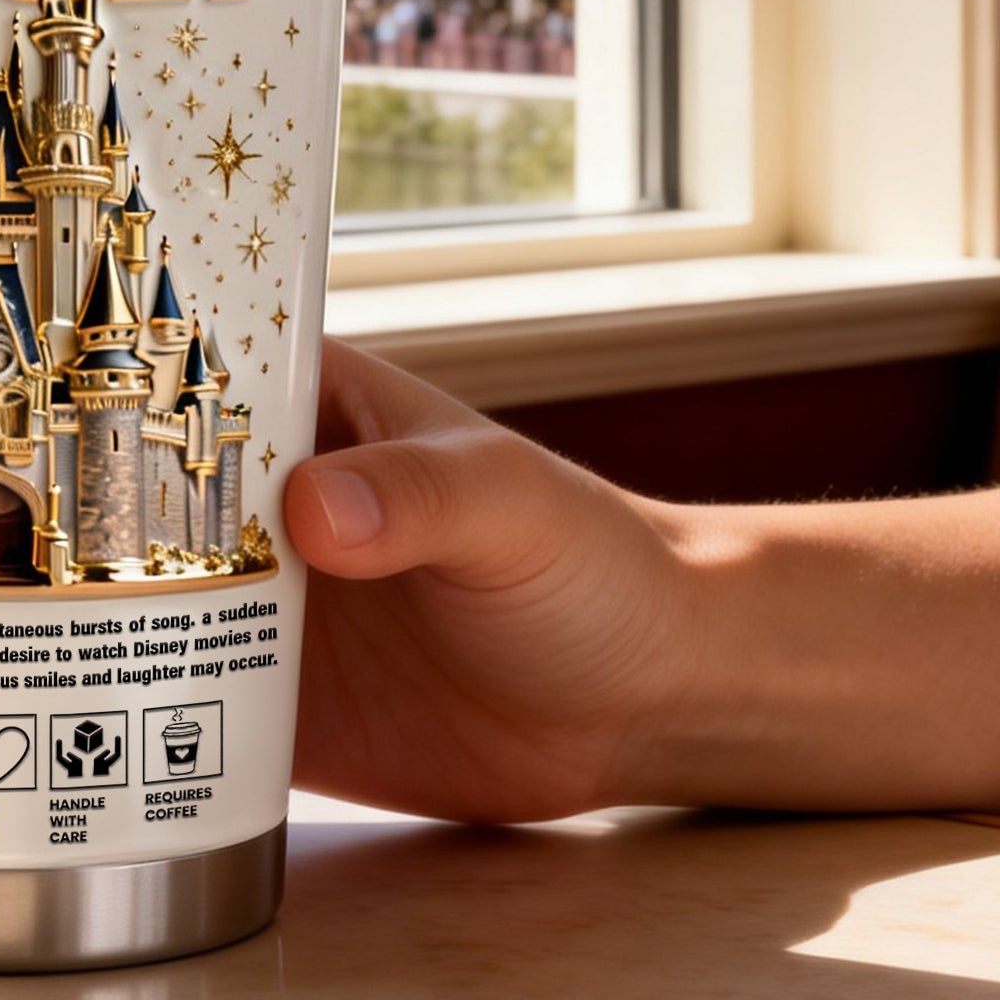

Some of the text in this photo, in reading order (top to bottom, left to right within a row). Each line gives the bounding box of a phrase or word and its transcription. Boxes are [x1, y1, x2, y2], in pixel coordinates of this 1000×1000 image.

[70, 619, 122, 636] bursts
[129, 616, 146, 632] of
[151, 614, 195, 631] song.
[202, 612, 211, 624] a
[219, 601, 277, 622] sudden
[0, 646, 50, 663] desire
[56, 648, 72, 661] to
[79, 642, 127, 660] watch
[134, 639, 188, 656] Disney
[194, 630, 251, 650] movies
[258, 627, 277, 641] on
[24, 671, 76, 688] smiles
[82, 668, 111, 686] and
[117, 665, 185, 685] laughter
[190, 660, 224, 677] may
[229, 652, 278, 671] occur.
[50, 797, 105, 811] HANDLE
[145, 787, 212, 805] REQUIRES
[50, 815, 87, 827] WITH
[145, 805, 197, 821] COFFEE
[50, 831, 87, 843] CARE
